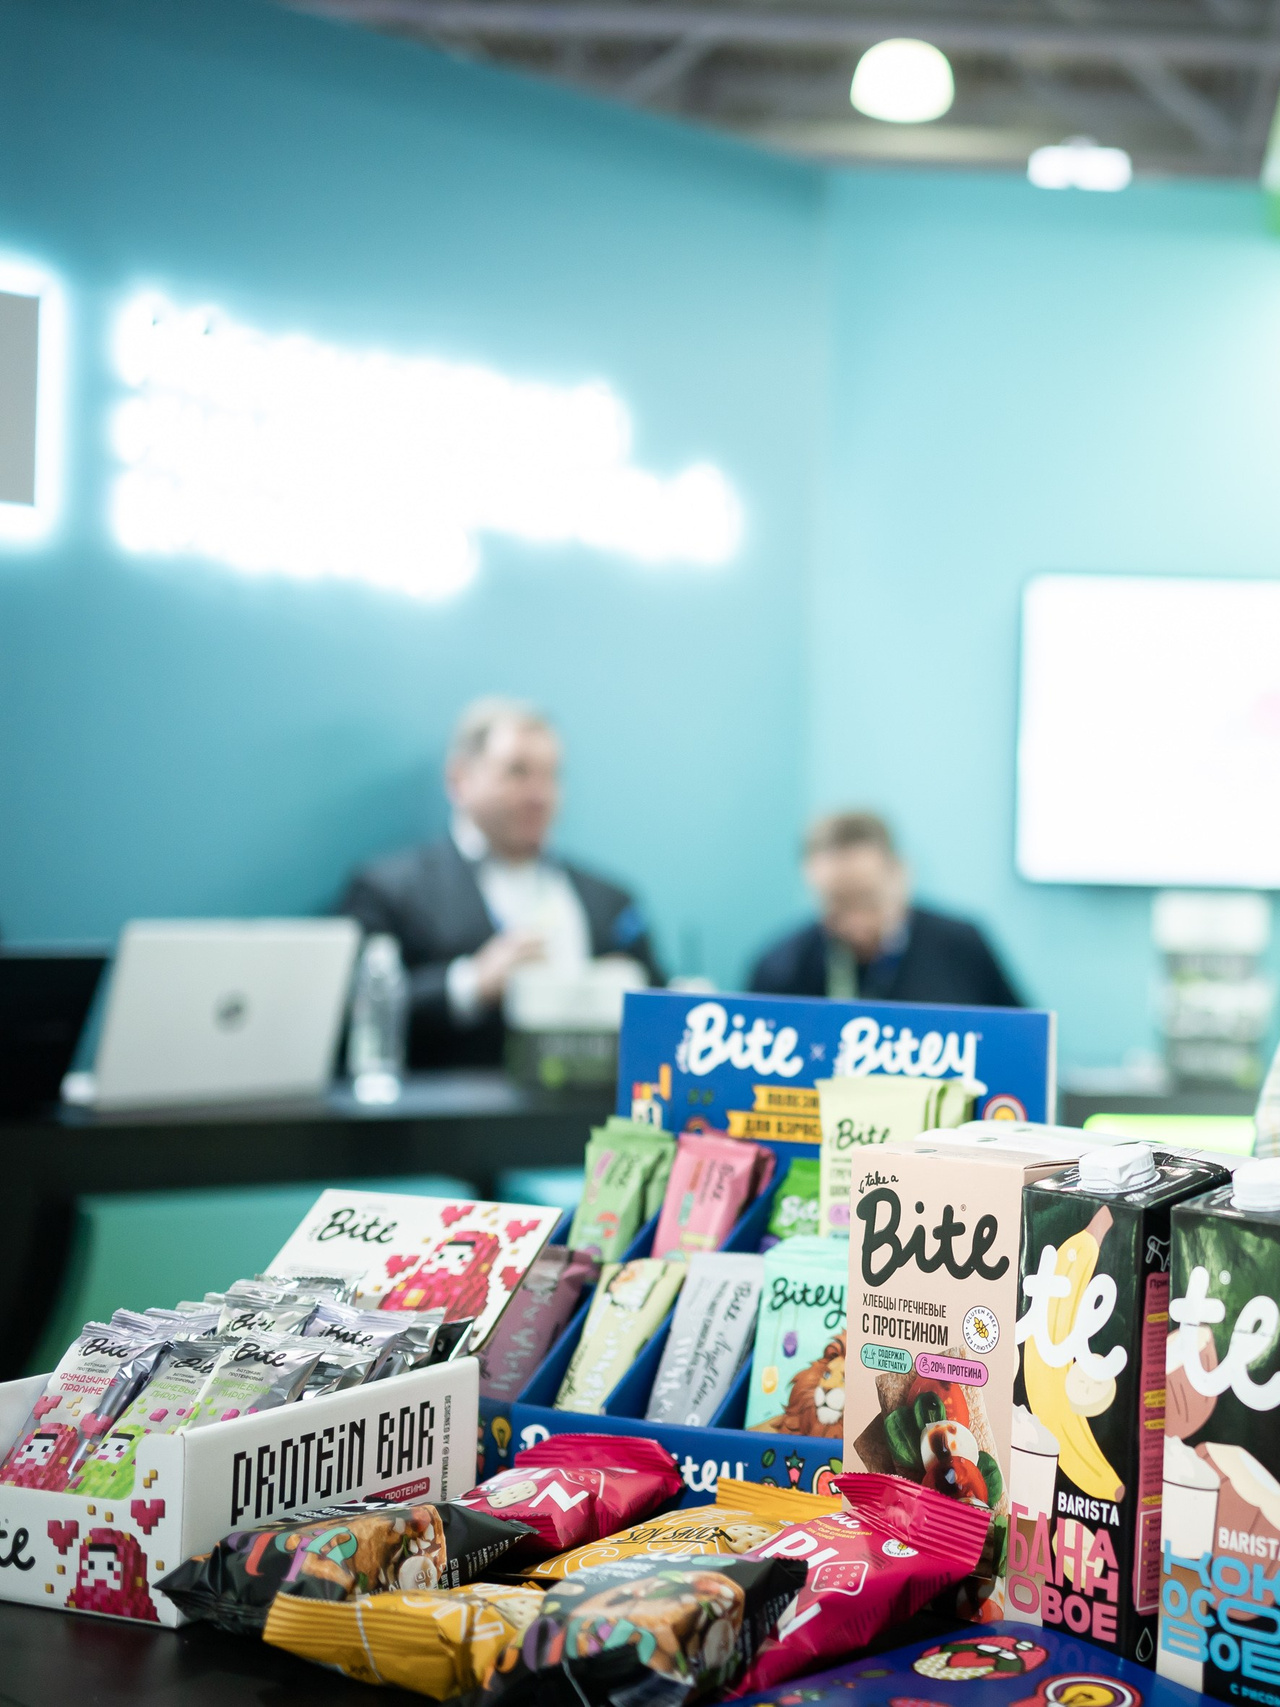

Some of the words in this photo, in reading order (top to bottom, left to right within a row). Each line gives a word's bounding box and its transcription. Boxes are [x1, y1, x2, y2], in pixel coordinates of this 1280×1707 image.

[686, 1002, 804, 1078] Bite
[840, 1016, 989, 1096] Bitey
[864, 1171, 889, 1187] take
[890, 1175, 900, 1183] a
[317, 1208, 398, 1244] Bite
[856, 1187, 1010, 1288] Bite
[771, 1277, 847, 1329] Bitey
[862, 1293, 897, 1312] ХЛЕБЦЫ
[898, 1298, 947, 1319] ГРЕЧНЕВЫЕ
[966, 1309, 985, 1324] GLUTEN
[986, 1312, 997, 1328] FREE
[862, 1313, 870, 1334] С
[872, 1316, 949, 1347] ПРОТЕИНОМ
[965, 1332, 974, 1345] БЕЗ
[973, 1336, 997, 1351] ГЛЮТЕНА
[173, 1357, 213, 1374] Bit
[234, 1342, 287, 1367] Bite
[877, 1348, 906, 1361] СОДЕРЖАТ
[877, 1358, 908, 1372] КЛЕТЧАТКУ
[59, 1372, 119, 1388] ФУНДУЧНОЕ
[930, 1361, 946, 1375] 20%
[946, 1363, 983, 1380] ПРОТЕИНА
[60, 1383, 104, 1396] ПРАЛИНЕ
[376, 1401, 435, 1480] BAR
[1058, 1491, 1120, 1527] BARISTA
